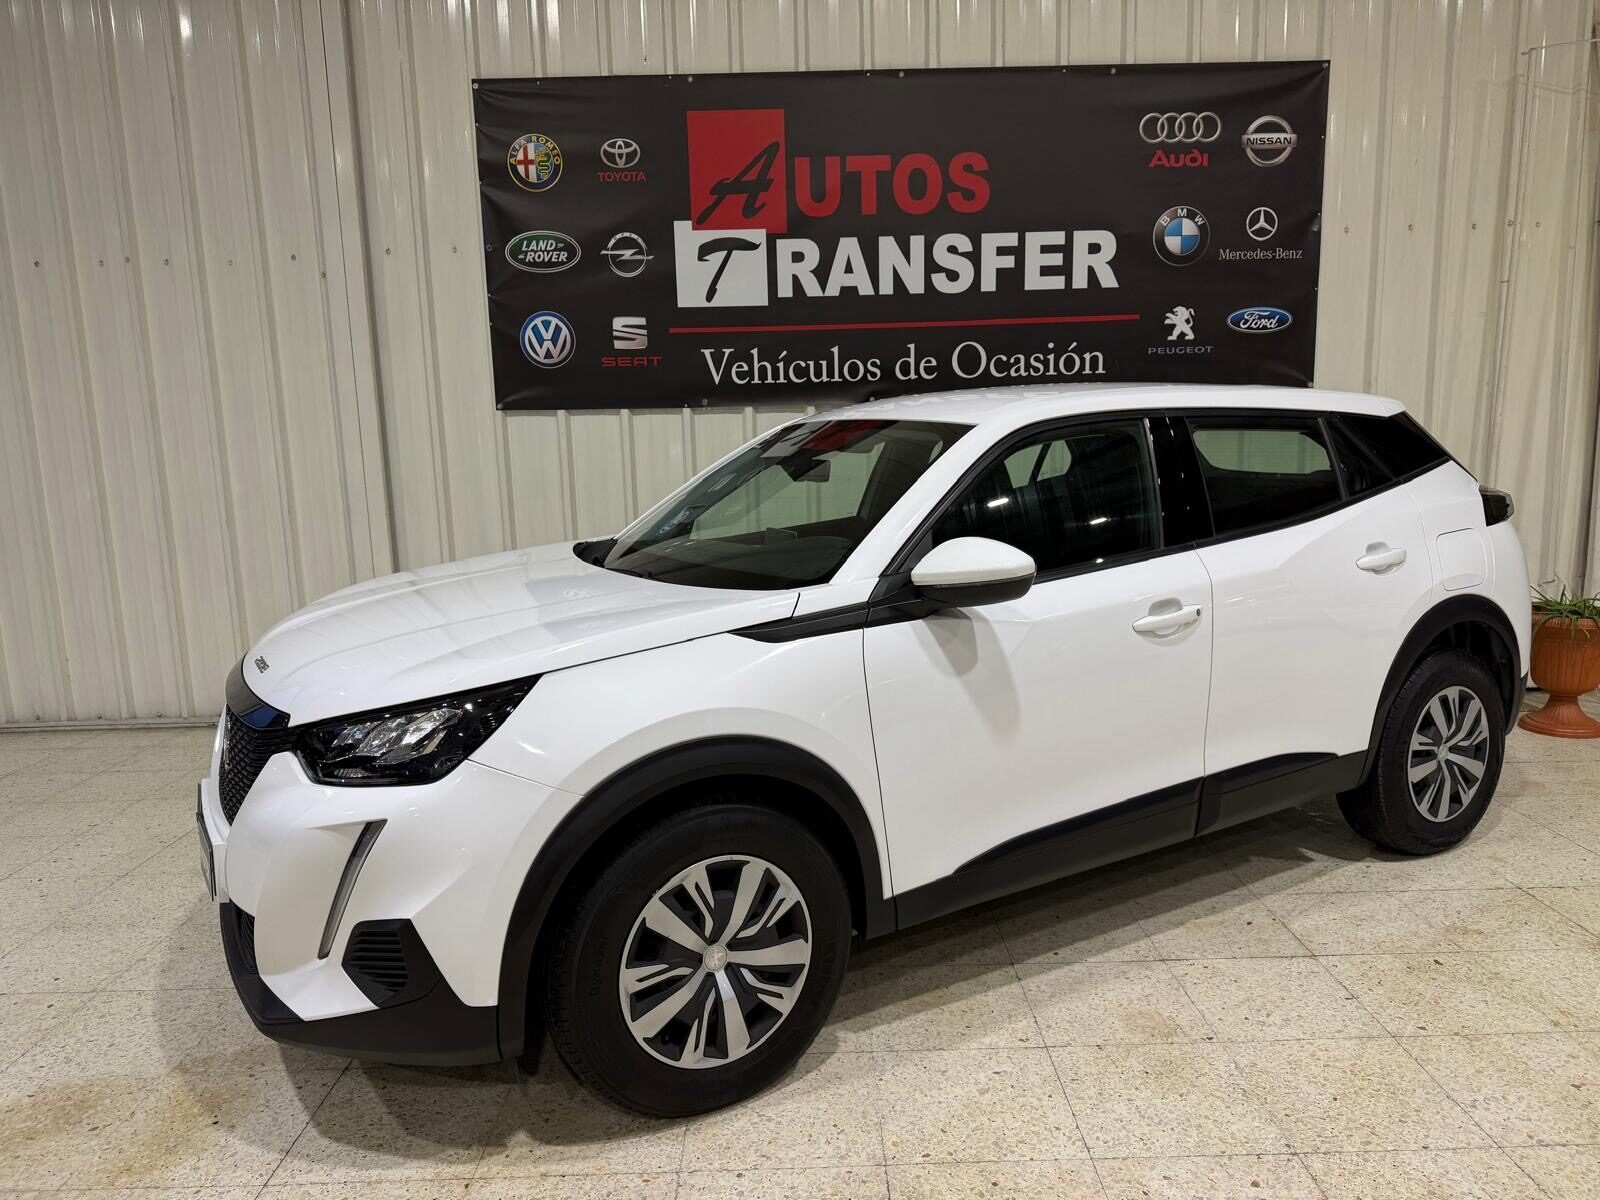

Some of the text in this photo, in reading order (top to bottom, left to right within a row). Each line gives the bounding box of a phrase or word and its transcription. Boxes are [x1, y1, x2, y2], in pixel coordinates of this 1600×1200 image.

[1246, 136, 1292, 146] NISSAN
[510, 135, 561, 165] ALFA ROMEO
[1148, 149, 1209, 167] Audi
[597, 171, 647, 183] TOYOTA
[695, 141, 991, 226] AUTOS
[1160, 208, 1205, 226] BMW
[521, 240, 556, 252] LAND
[1218, 247, 1303, 261] Mercedes-Benz
[525, 250, 568, 263] ROVER
[697, 229, 1120, 304] TRANSFER
[1239, 311, 1279, 329] Ford
[1148, 345, 1215, 355] PEUGEOT
[600, 356, 663, 368] SEAT
[701, 341, 1107, 385] Vehículos de Ocasión
